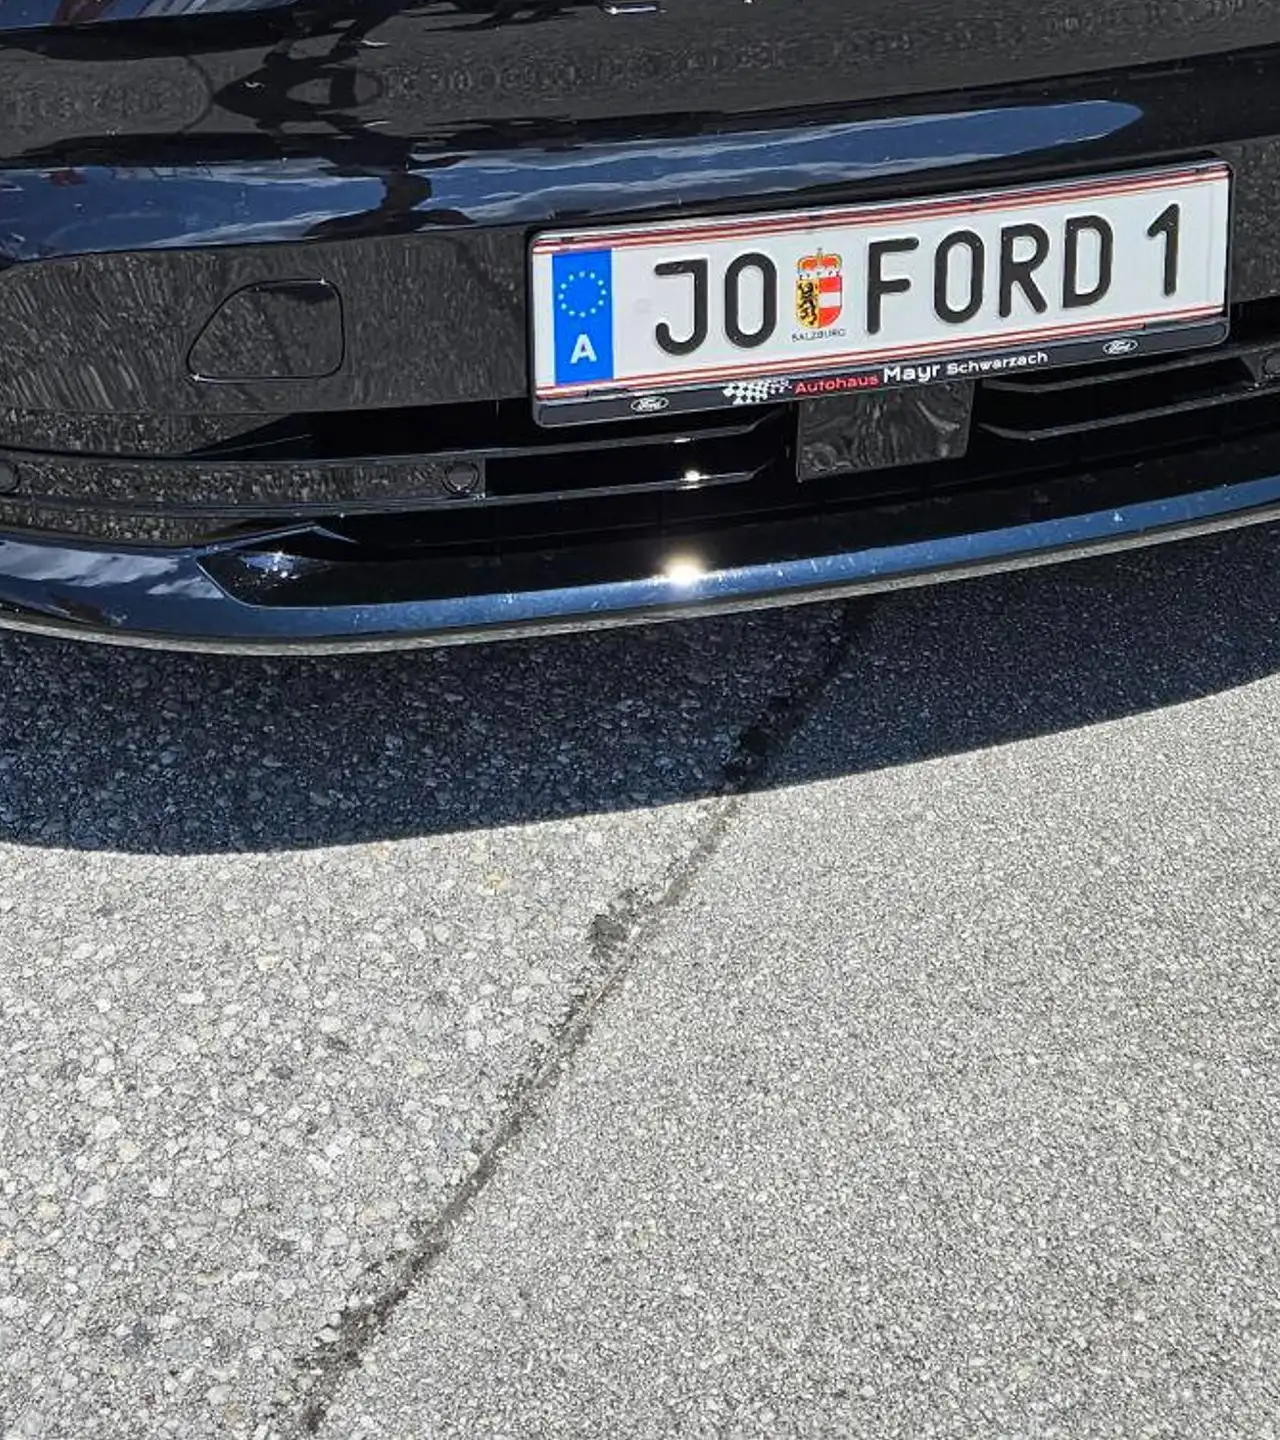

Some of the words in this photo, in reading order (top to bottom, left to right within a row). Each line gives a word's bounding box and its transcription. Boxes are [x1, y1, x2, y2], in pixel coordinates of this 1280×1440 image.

[652, 250, 778, 357] JO
[866, 213, 1115, 335] FORD
[1147, 202, 1181, 298] 1
[569, 333, 598, 365] A
[791, 328, 847, 343] SALZBURG
[794, 373, 880, 396] Autohaus
[883, 363, 941, 383] Mayr
[946, 351, 1049, 376] Schwarzach
